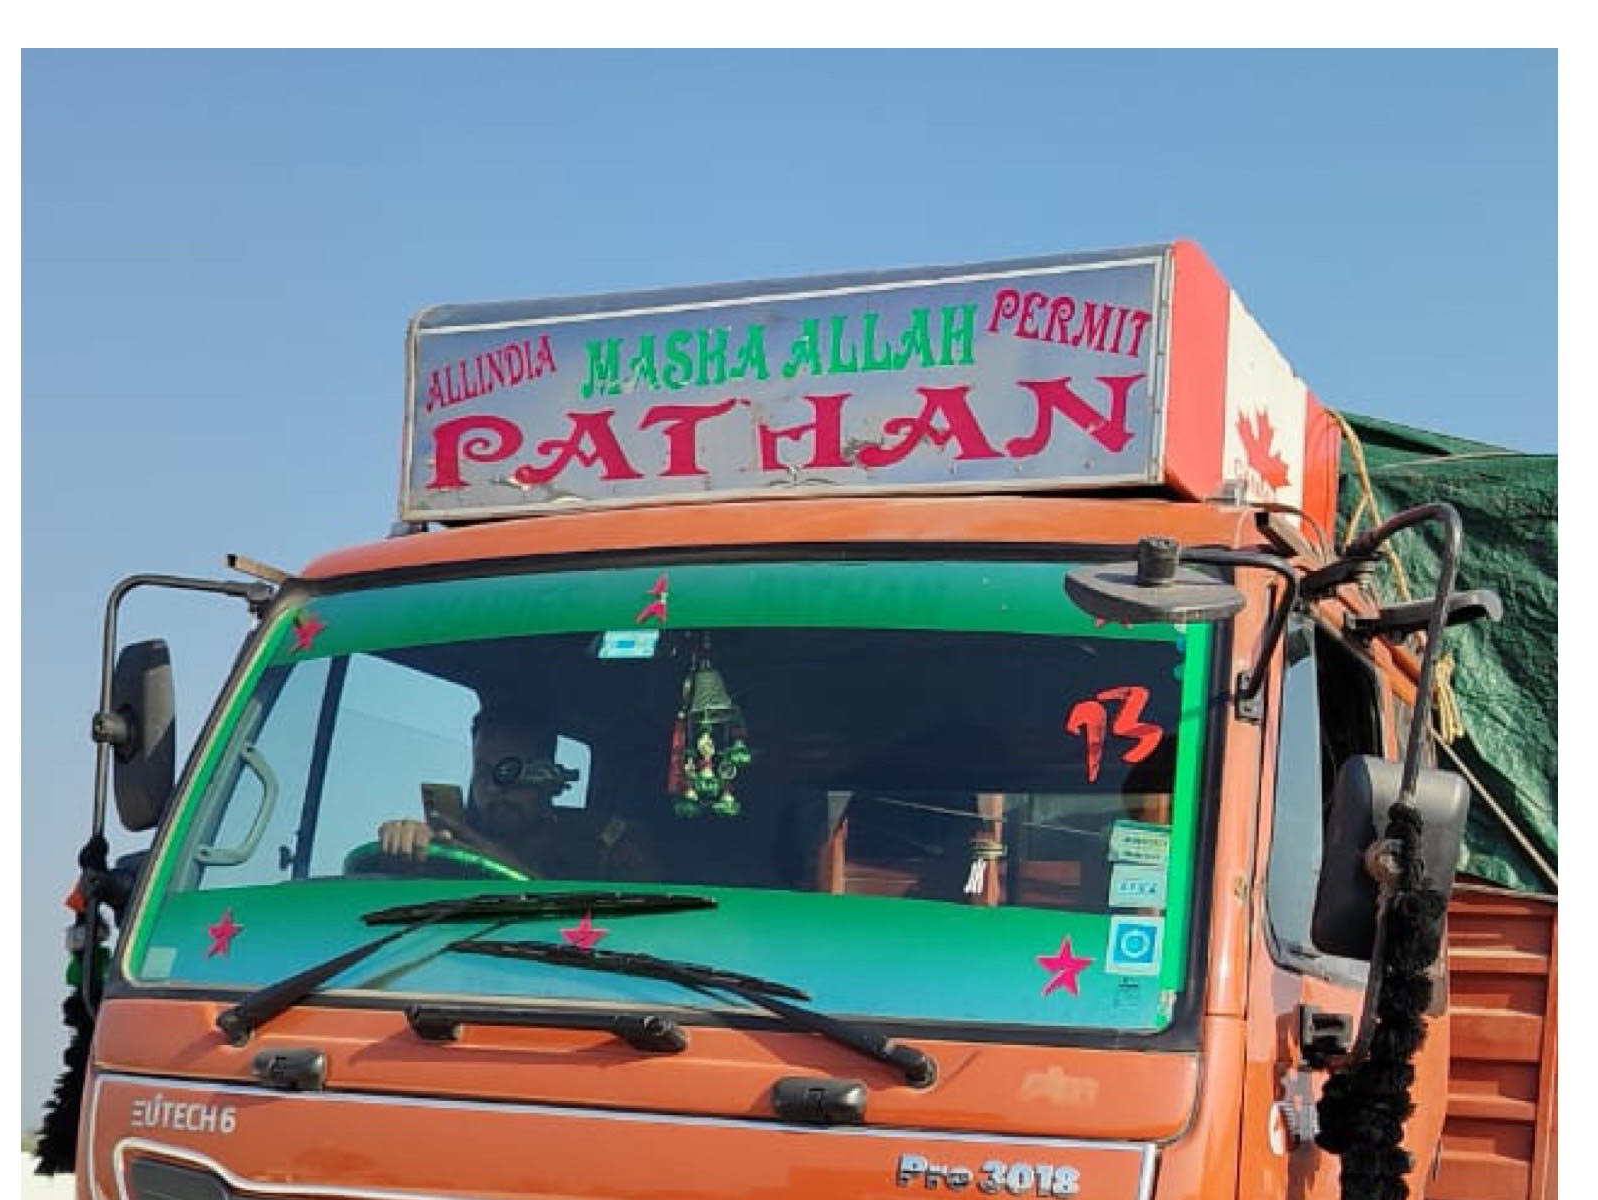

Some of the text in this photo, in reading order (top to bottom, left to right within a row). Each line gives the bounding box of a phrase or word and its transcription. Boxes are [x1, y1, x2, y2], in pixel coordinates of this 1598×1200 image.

[581, 305, 979, 399] MASHA ALLAH
[987, 285, 1151, 357] PERMIT
[425, 374, 1146, 489] PATHAN
[897, 1154, 1081, 1198] Pro 3018
